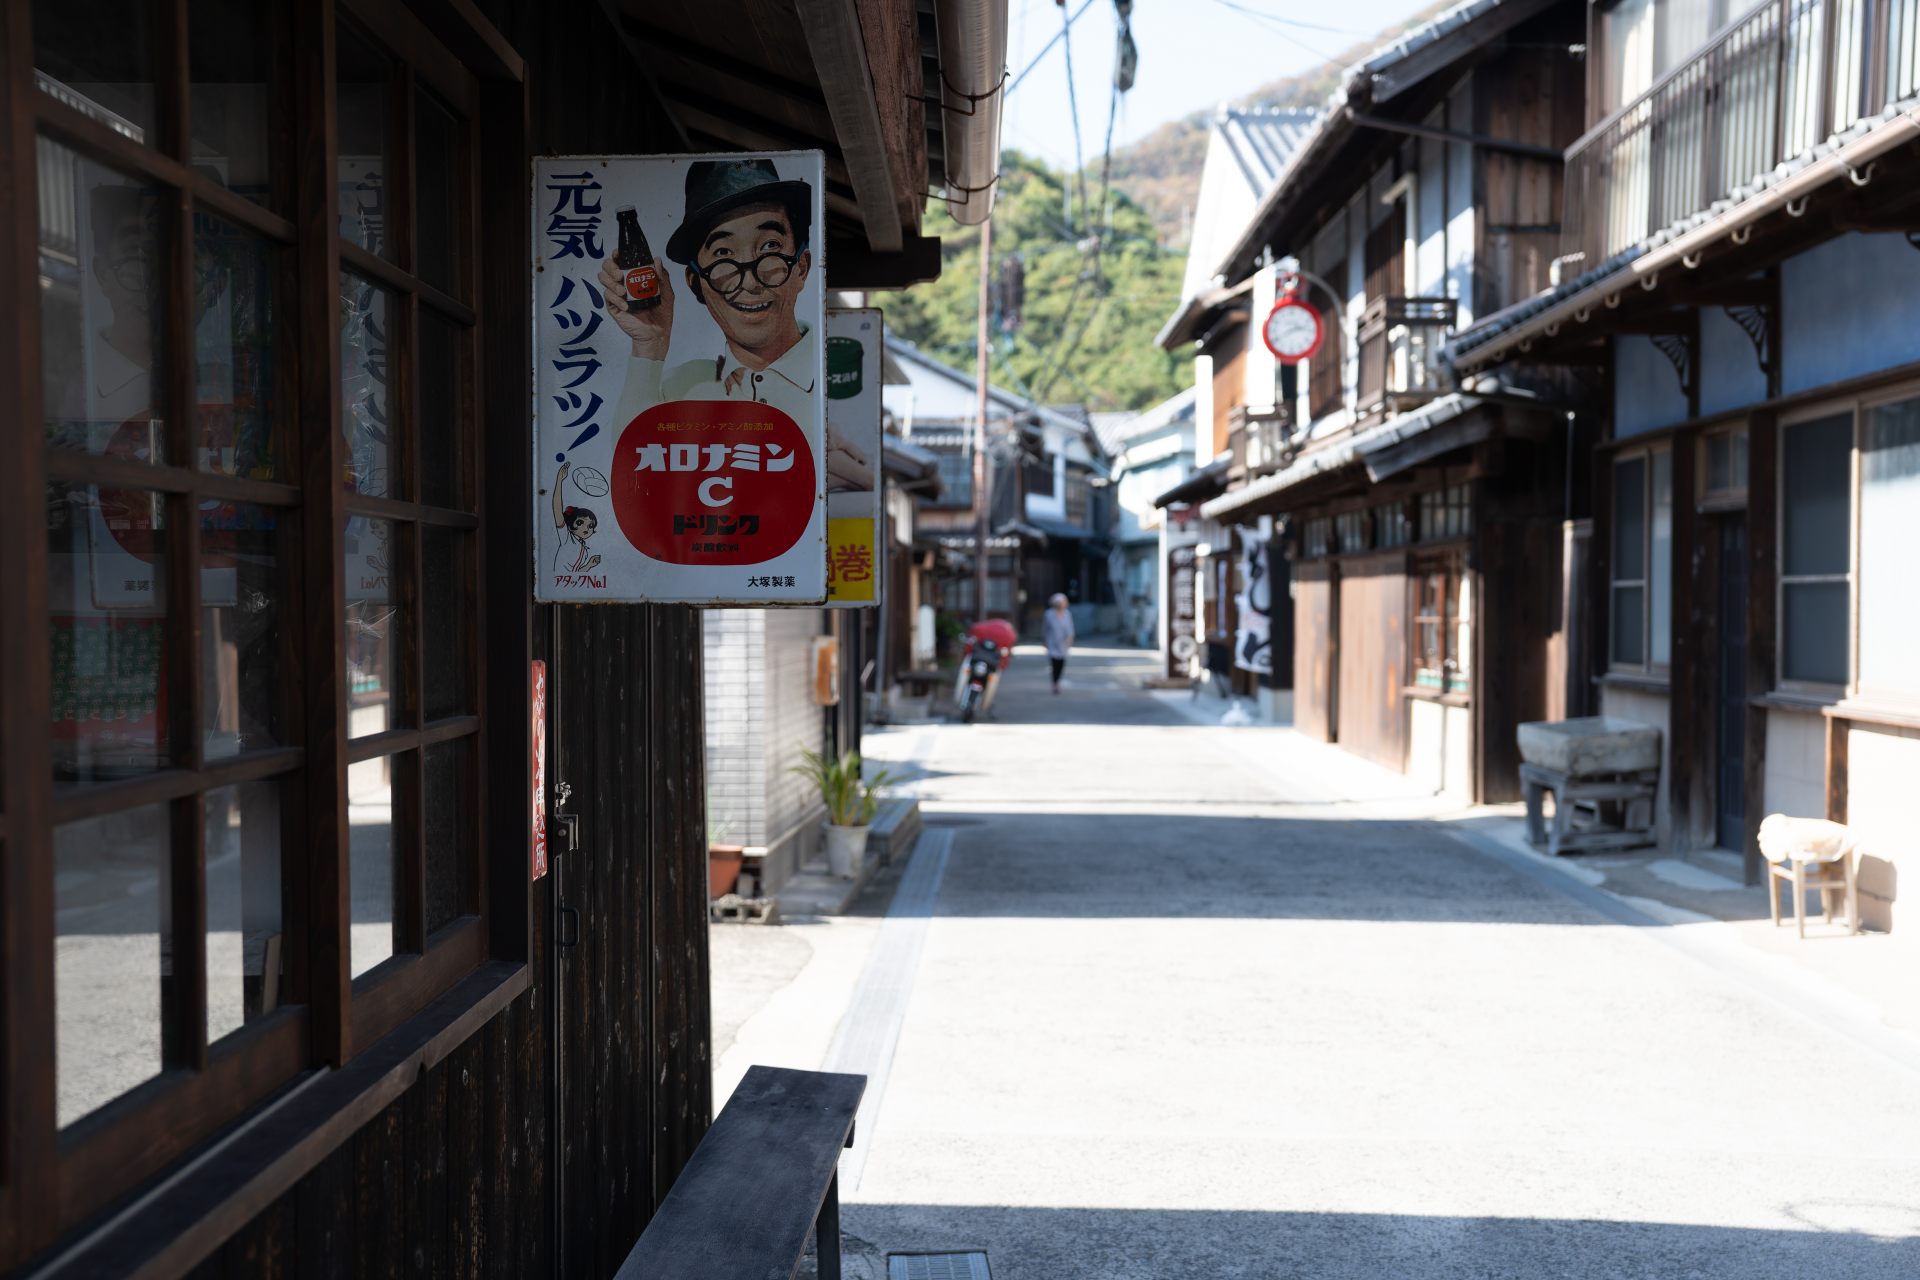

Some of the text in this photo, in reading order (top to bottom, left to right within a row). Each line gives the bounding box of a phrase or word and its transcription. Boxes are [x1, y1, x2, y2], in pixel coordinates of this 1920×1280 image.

[634, 443, 796, 473] オロナミン
[697, 476, 734, 507] C
[673, 514, 760, 535] ドリンク
[747, 575, 796, 588] 大塚製薬
